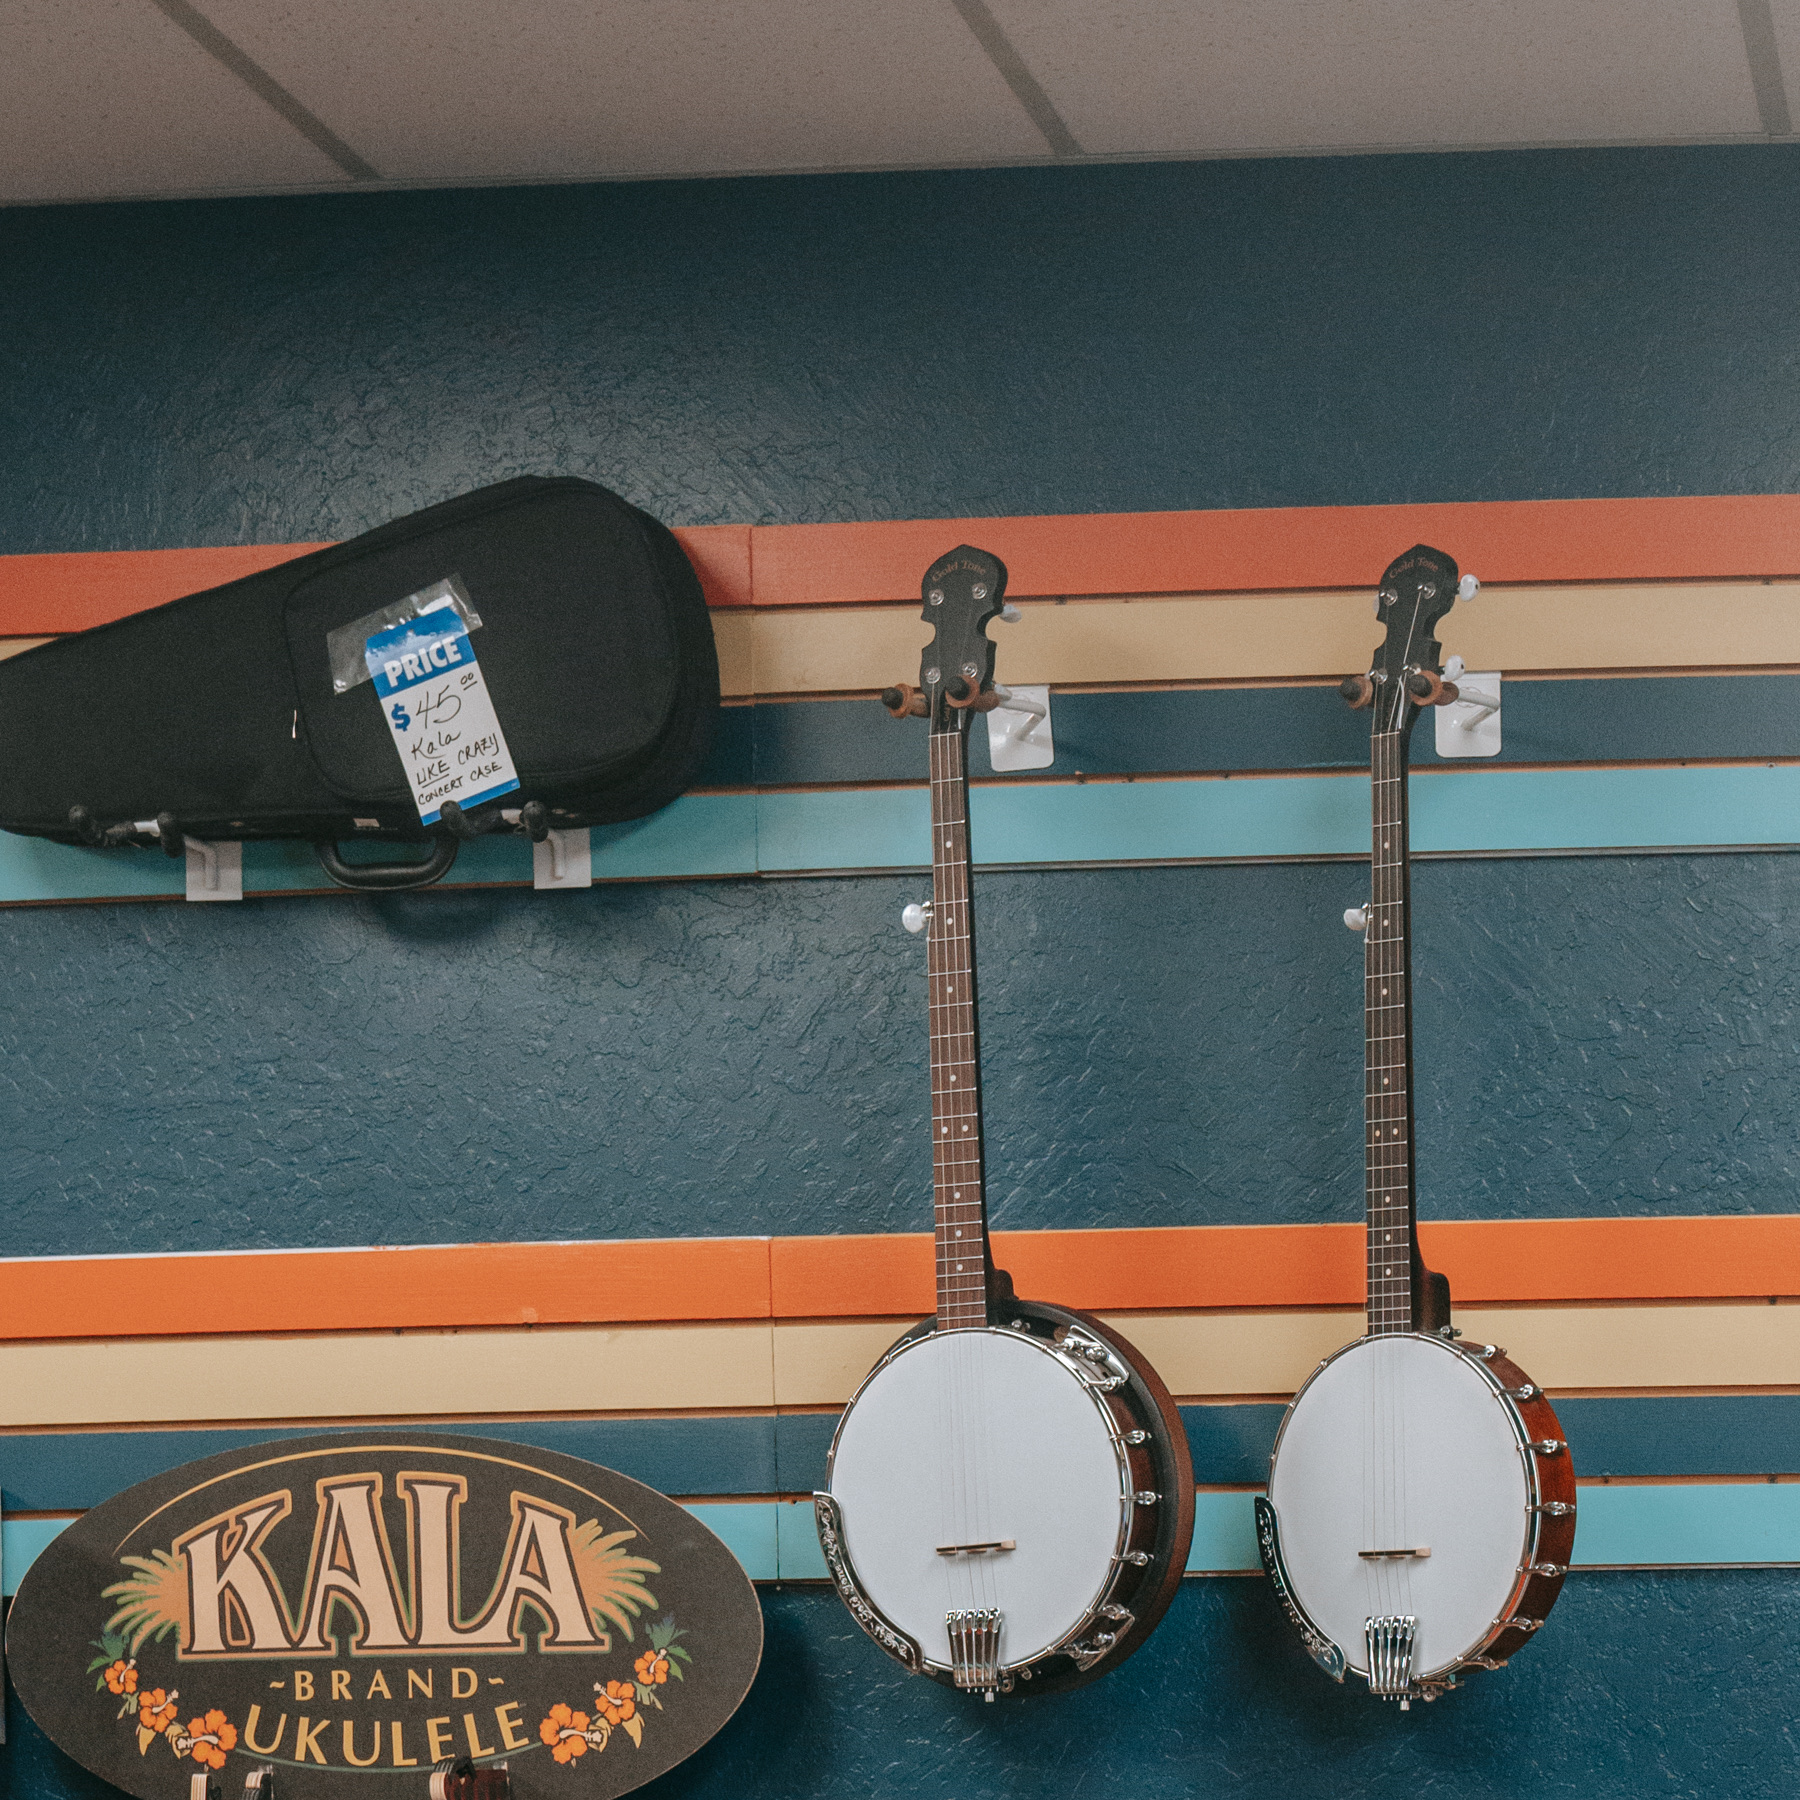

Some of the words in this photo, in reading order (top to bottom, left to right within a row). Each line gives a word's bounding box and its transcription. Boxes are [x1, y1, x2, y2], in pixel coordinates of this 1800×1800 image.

[931, 561, 959, 582] Gold
[961, 560, 986, 576] Tone
[1389, 560, 1415, 579] Gold
[1417, 556, 1439, 573] Tone
[383, 636, 462, 688] PRICE
[411, 731, 462, 760] Kala
[457, 732, 500, 766] CRAZY
[417, 776, 464, 806] CONCERT
[469, 760, 503, 782] CASE
[172, 1472, 611, 1660] KALA
[294, 1667, 479, 1702] BRAND
[243, 1701, 530, 1767] UKULELE
